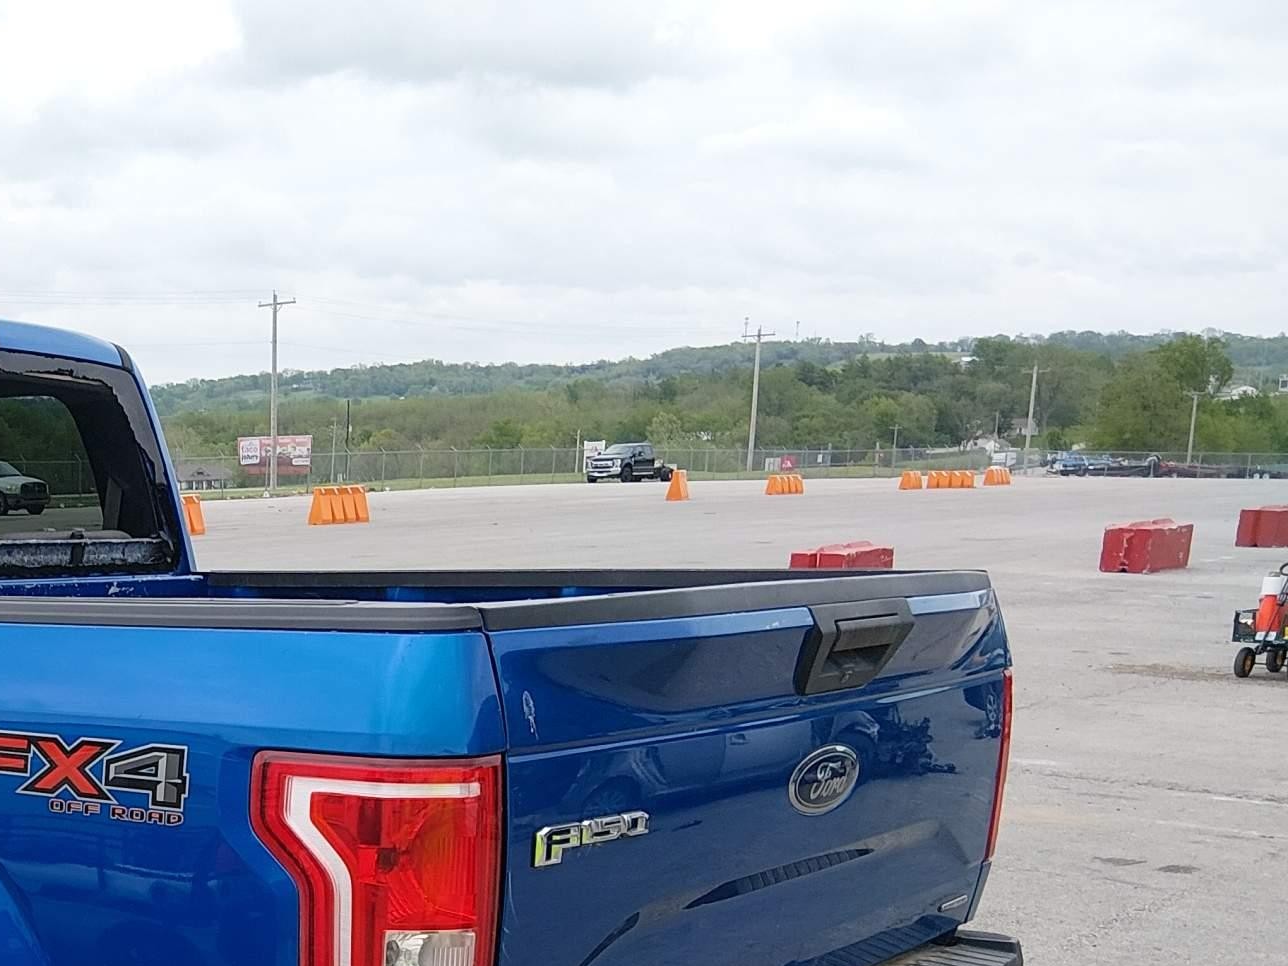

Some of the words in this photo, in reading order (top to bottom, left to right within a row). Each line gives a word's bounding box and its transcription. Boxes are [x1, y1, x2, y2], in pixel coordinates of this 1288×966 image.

[809, 760, 851, 800] Ford
[48, 798, 101, 816] OFF
[109, 805, 184, 827] ROAD
[532, 810, 650, 868] F150
